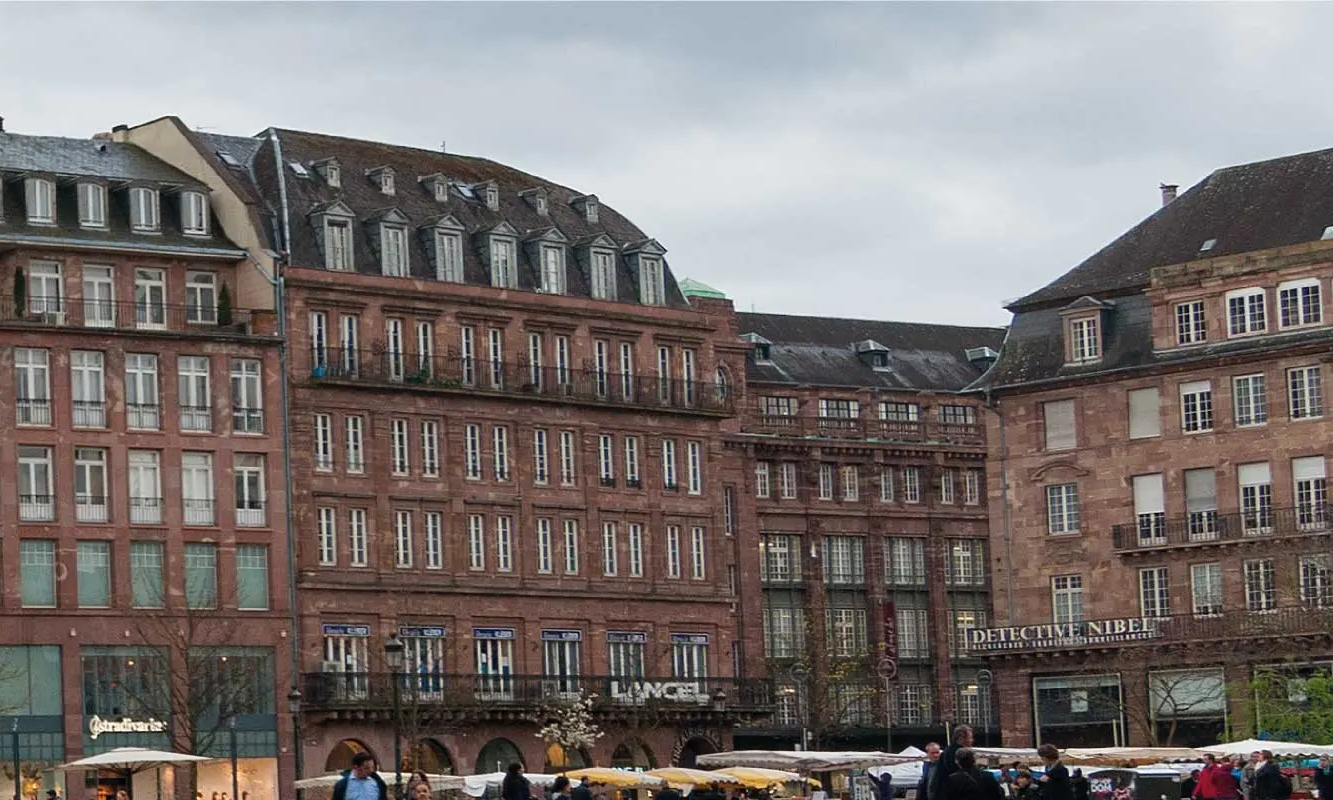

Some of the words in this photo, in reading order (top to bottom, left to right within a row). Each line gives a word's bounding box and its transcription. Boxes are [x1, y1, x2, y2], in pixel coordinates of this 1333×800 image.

[973, 624, 1080, 643] DETECTIVE
[1088, 617, 1153, 636] NIBEL
[611, 681, 710, 701] LANCEL
